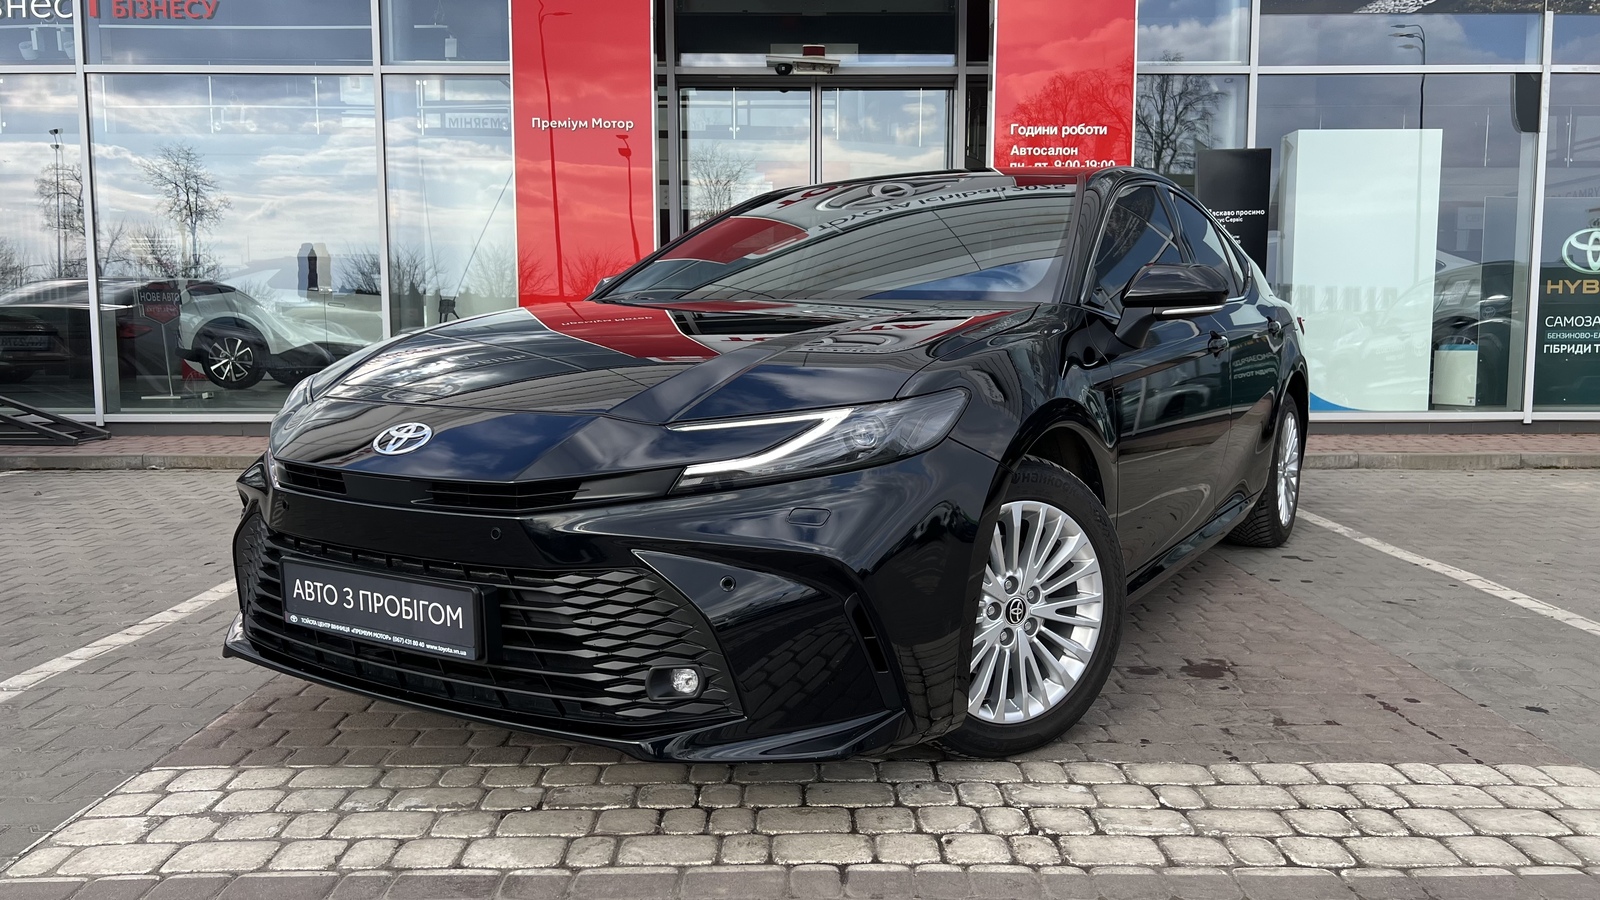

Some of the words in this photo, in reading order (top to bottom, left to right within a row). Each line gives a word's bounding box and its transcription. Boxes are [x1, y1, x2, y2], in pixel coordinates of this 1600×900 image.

[0, 0, 73, 18] нес
[111, 0, 219, 19] БІЗНЕСУ
[531, 117, 588, 131] Преміум
[591, 117, 635, 132] Мотор
[1010, 123, 1058, 137] Години
[1061, 123, 1108, 138] роботи
[1010, 144, 1079, 156] Автосалон
[139, 292, 161, 302] НОВЕ
[162, 292, 180, 302] АВТО
[1543, 344, 1592, 355] ГІБРИДИ
[293, 578, 338, 606] АВТО
[359, 590, 463, 629] ПРОБІГОМ
[301, 617, 317, 626] ТОЙОТА
[317, 620, 331, 629] ЦЕНТР
[392, 635, 404, 644] (067)
[404, 637, 413, 647] 431
[412, 639, 419, 647] 80
[425, 643, 467, 657] www.toyota.vn.ua
